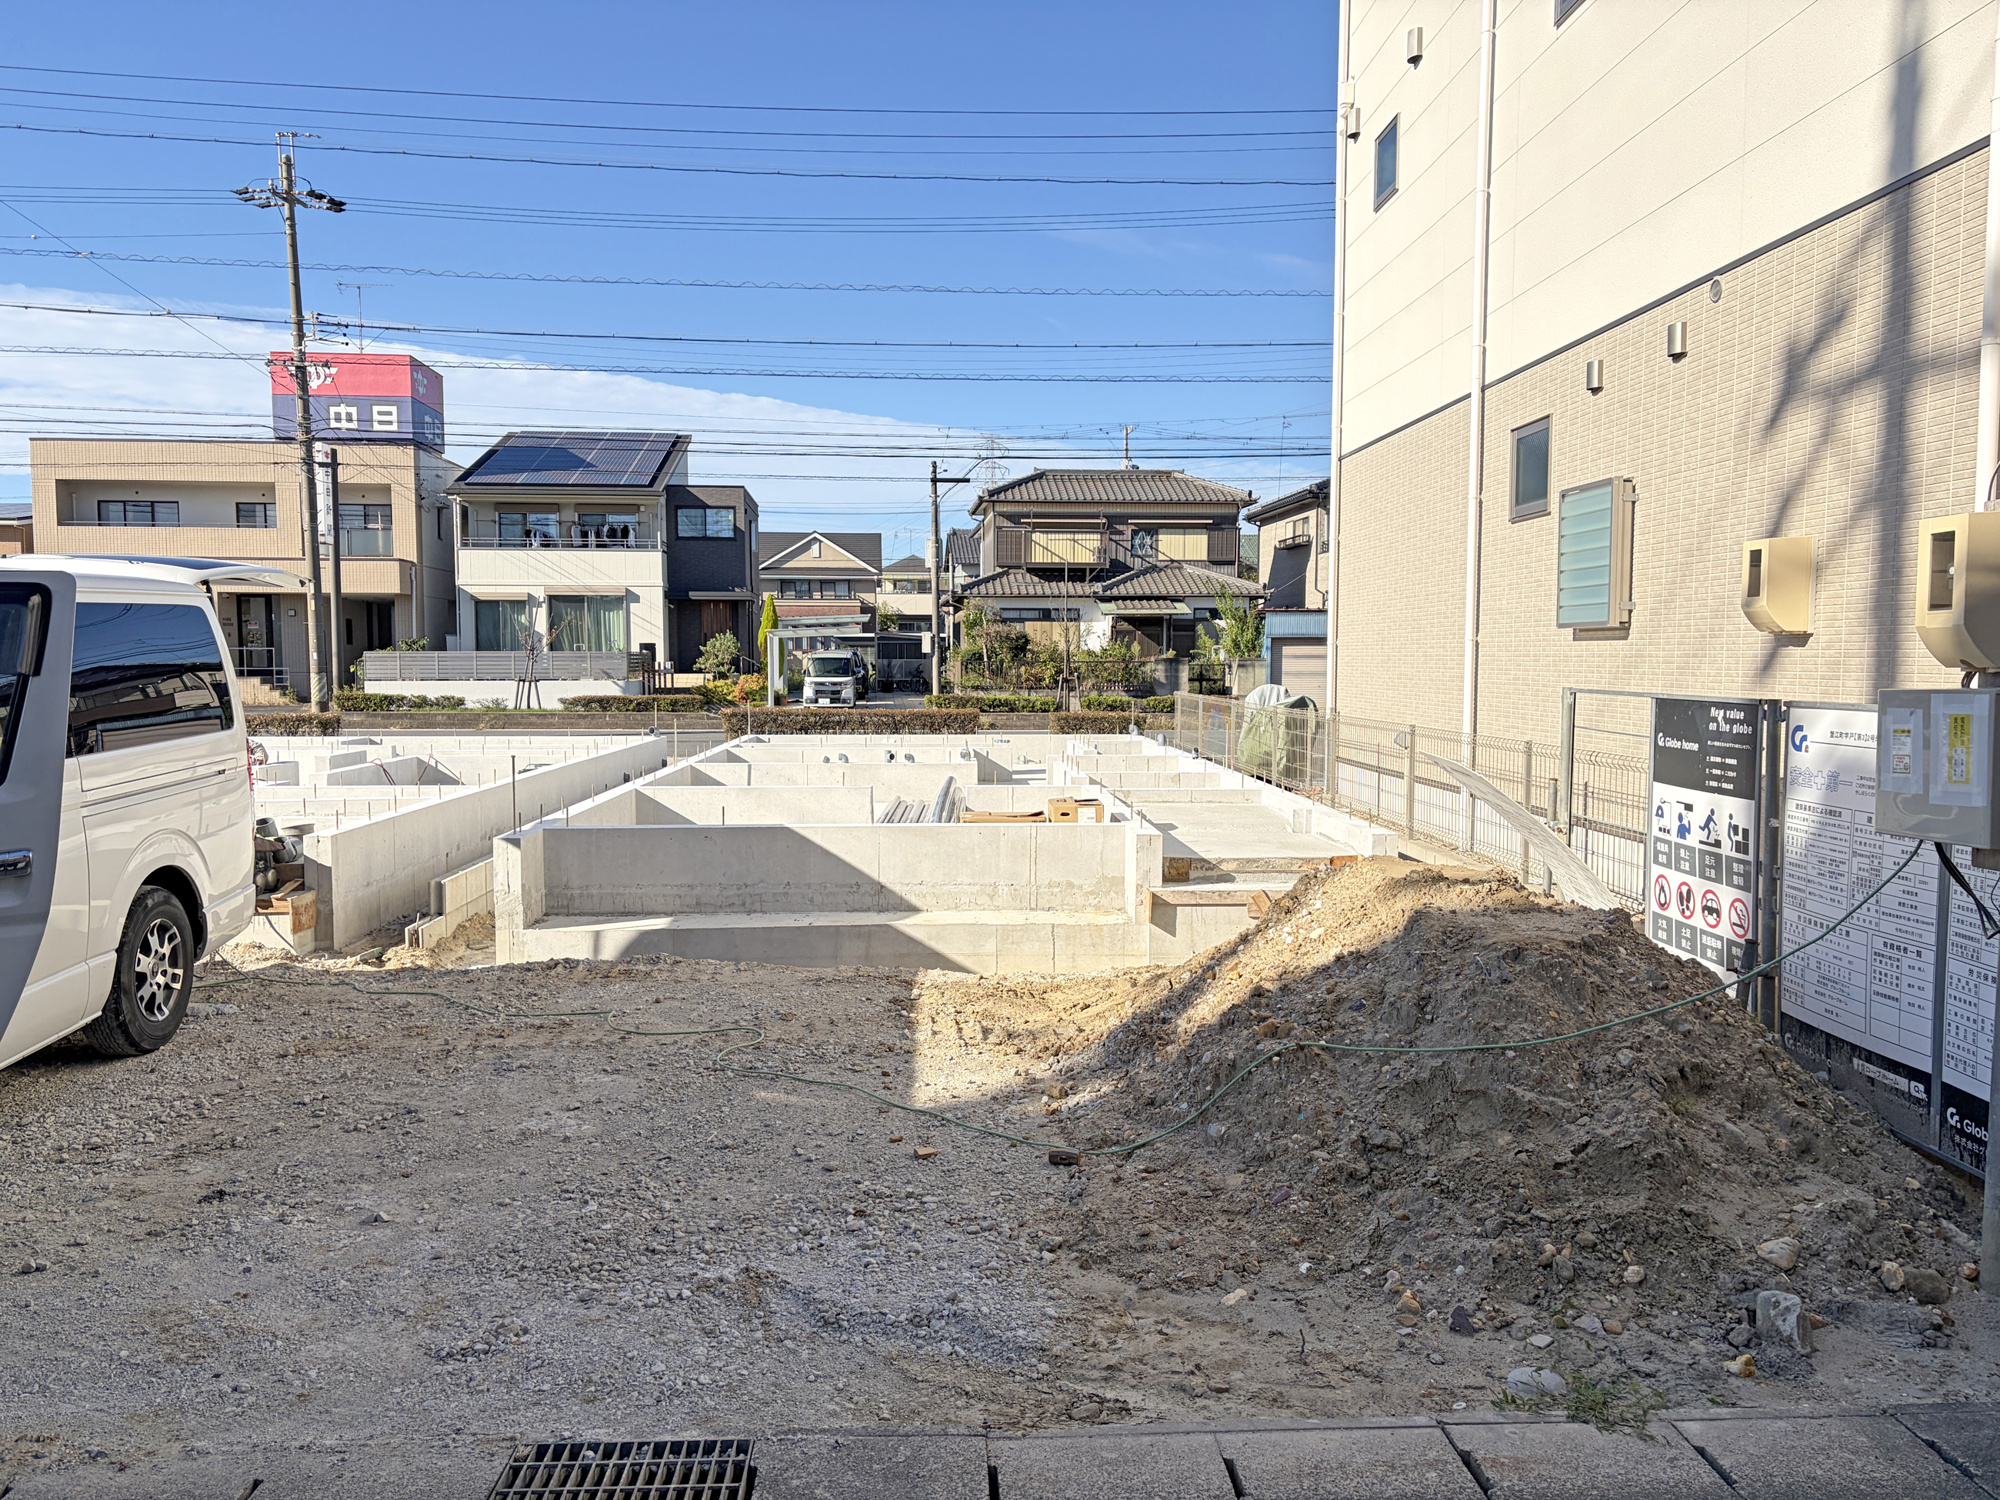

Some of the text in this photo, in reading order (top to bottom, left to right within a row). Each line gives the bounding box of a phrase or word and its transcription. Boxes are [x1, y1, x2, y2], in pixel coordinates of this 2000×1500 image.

[329, 403, 397, 431] 中日
[424, 414, 443, 442] 中日
[1726, 708, 1744, 719] value
[1709, 721, 1717, 731] on
[1732, 722, 1752, 734] globe
[1665, 736, 1699, 751] Globe home
[1795, 802, 1842, 818] 建築基準法による確認済
[1705, 855, 1716, 866] 足元
[1680, 862, 1690, 872] 注意
[1733, 863, 1744, 874] 整理
[1705, 868, 1716, 879] 注意
[1658, 919, 1667, 930] 火気
[1681, 927, 1691, 939] 土足
[1882, 940, 1922, 958] 有資格者一覧
[1963, 1119, 1988, 1142] Glob
